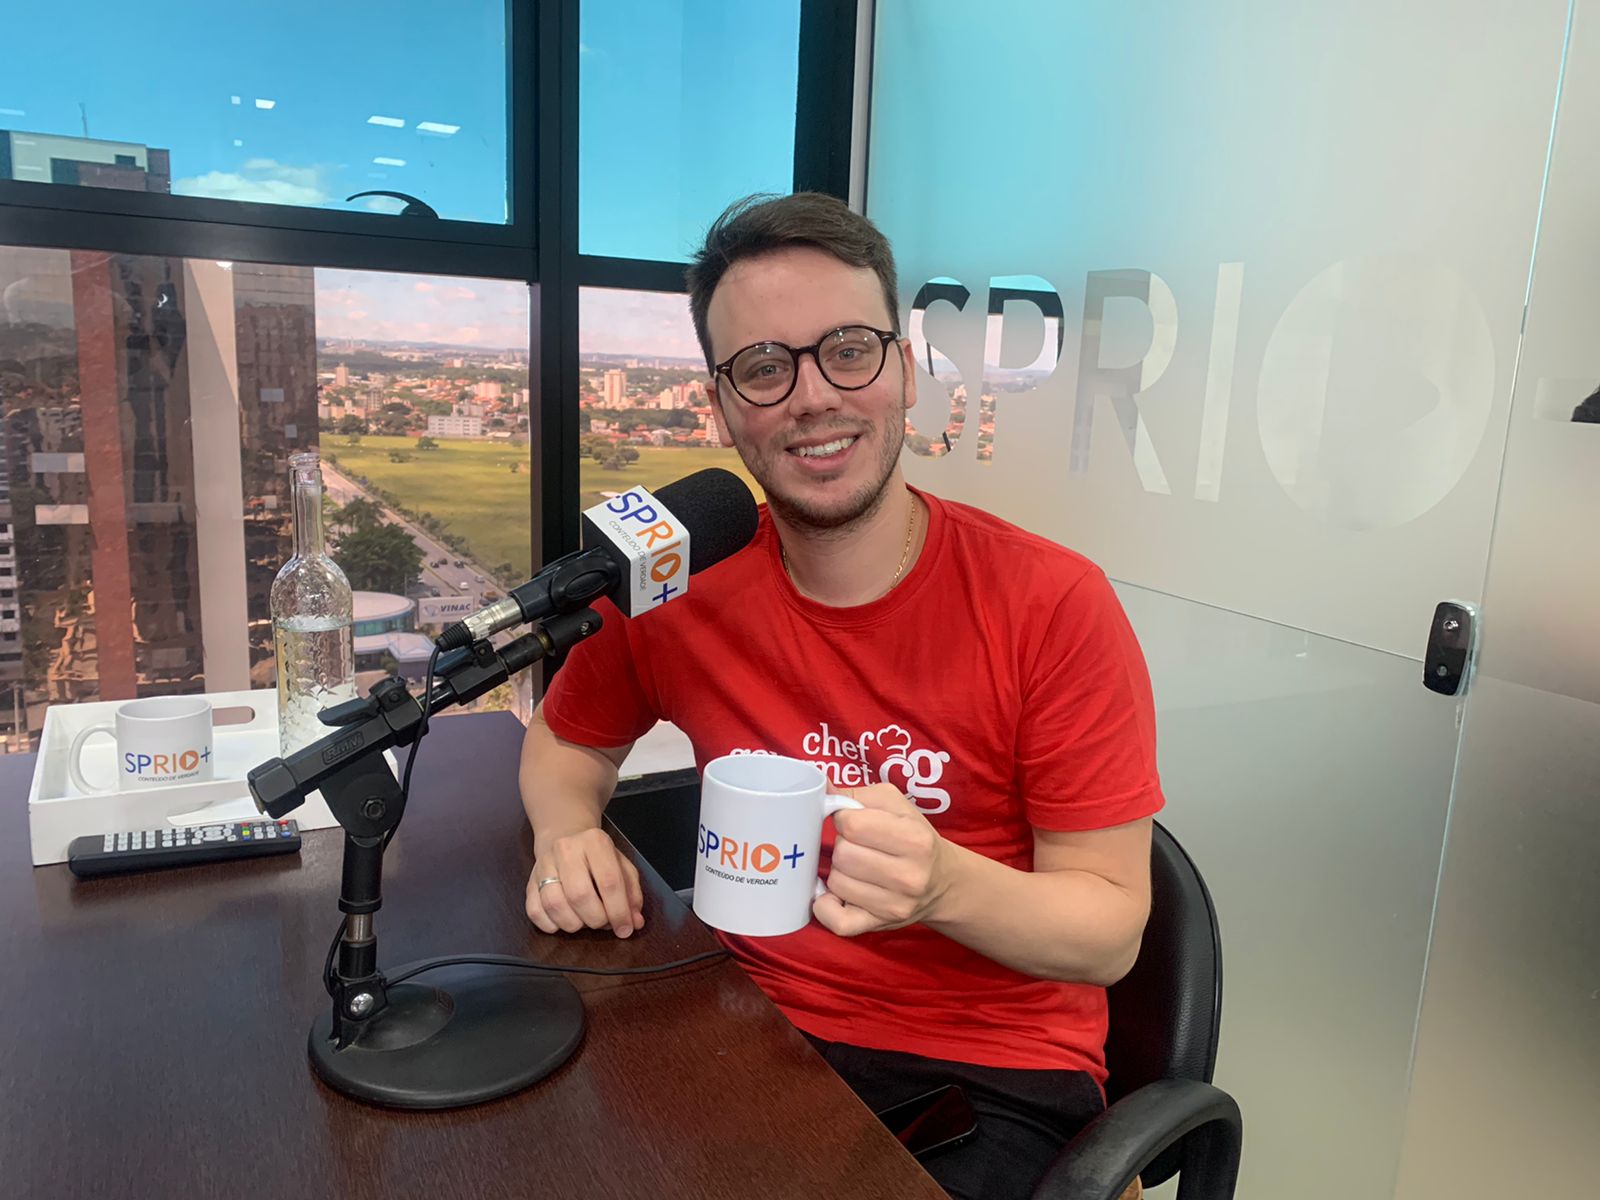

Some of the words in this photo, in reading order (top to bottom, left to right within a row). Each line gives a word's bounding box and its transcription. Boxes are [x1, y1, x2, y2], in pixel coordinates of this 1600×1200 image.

[441, 603, 471, 612] VINAC
[802, 722, 874, 764] chef
[746, 878, 779, 886] VERDADE
